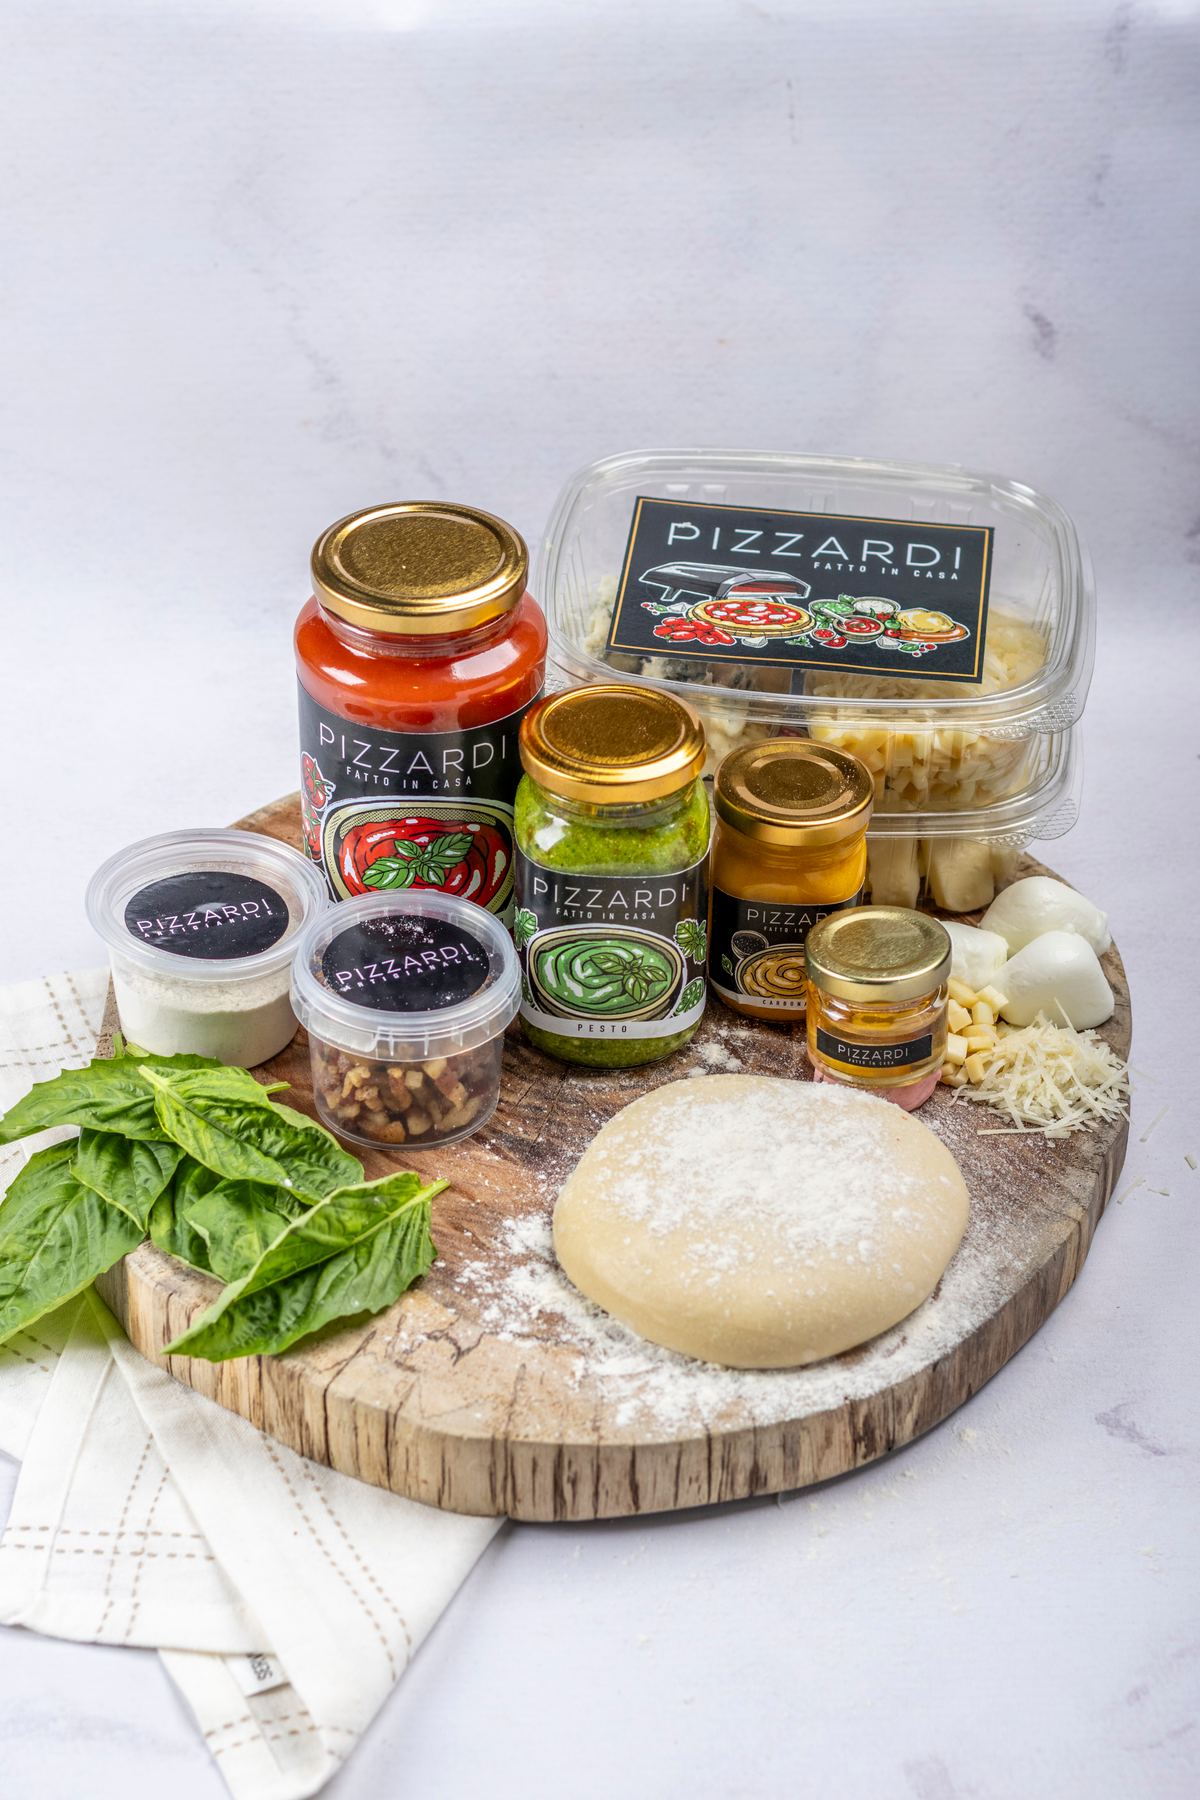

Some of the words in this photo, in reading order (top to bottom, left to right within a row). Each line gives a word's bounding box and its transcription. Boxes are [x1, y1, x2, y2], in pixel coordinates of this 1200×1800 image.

[667, 521, 962, 570] PIZZARDI
[813, 561, 868, 573] FATTO
[881, 566, 899, 576] IN
[913, 569, 960, 580] CASA
[319, 722, 506, 775] PIZZARDI
[346, 766, 390, 786] FATTO
[403, 779, 419, 790] IN
[432, 776, 472, 790] CASA
[533, 877, 687, 909] PIZZARDI
[136, 898, 271, 933] PIZZARDI
[143, 910, 274, 938] ARTIGIANALE
[556, 907, 593, 920] FATTO
[602, 912, 615, 920] IN
[624, 912, 656, 920] CASA
[747, 908, 829, 926] PIZZAR
[335, 943, 470, 985] PIZZARDI
[762, 999, 807, 1007] CARBON
[577, 1023, 628, 1033] PESTO
[837, 1044, 908, 1060] PIZZARDI
